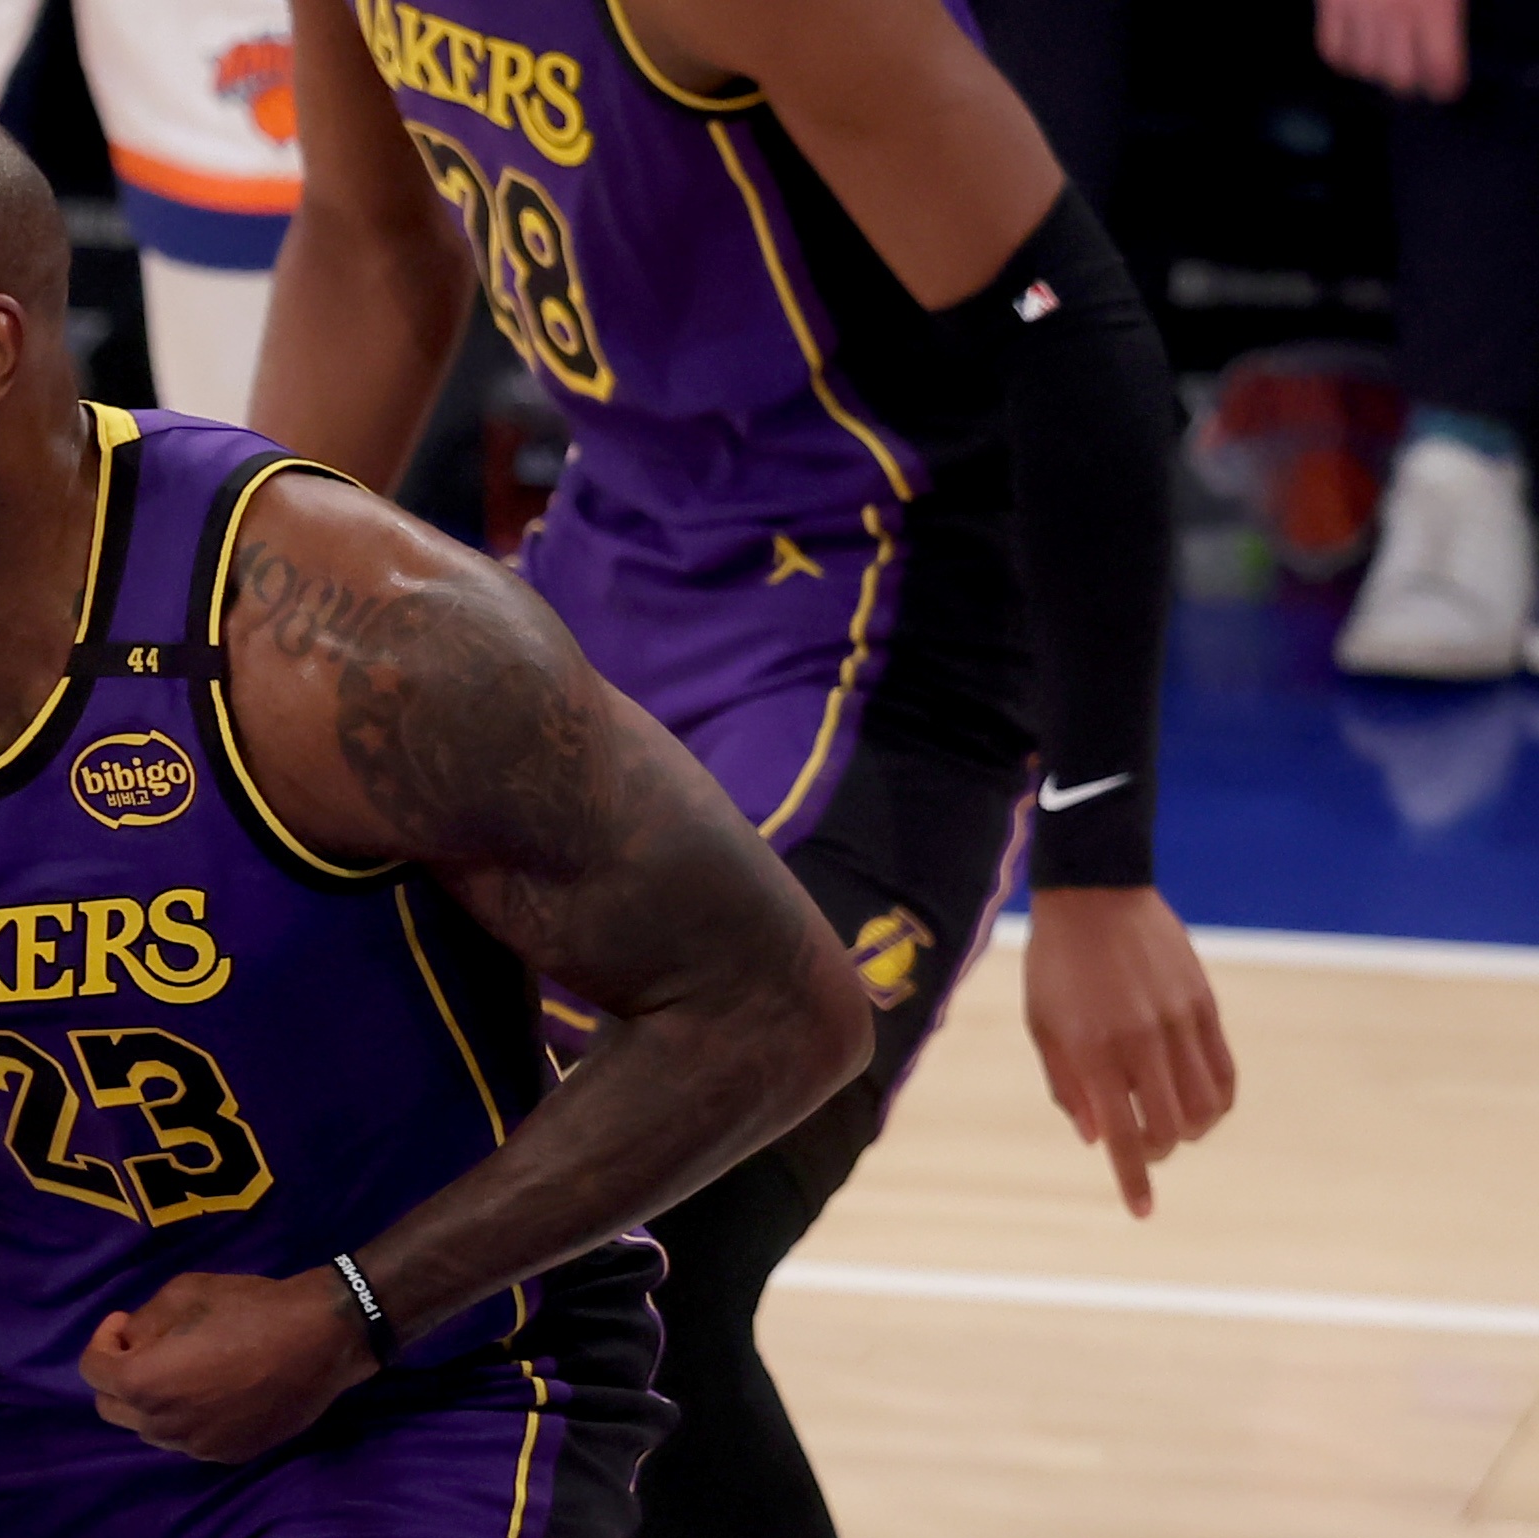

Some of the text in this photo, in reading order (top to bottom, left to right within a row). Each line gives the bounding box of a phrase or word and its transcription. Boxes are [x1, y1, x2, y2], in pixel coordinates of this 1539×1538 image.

[403, 119, 616, 403] 28
[126, 646, 161, 674] 44
[80, 757, 187, 798] bibigo
[106, 790, 151, 807] 비비고
